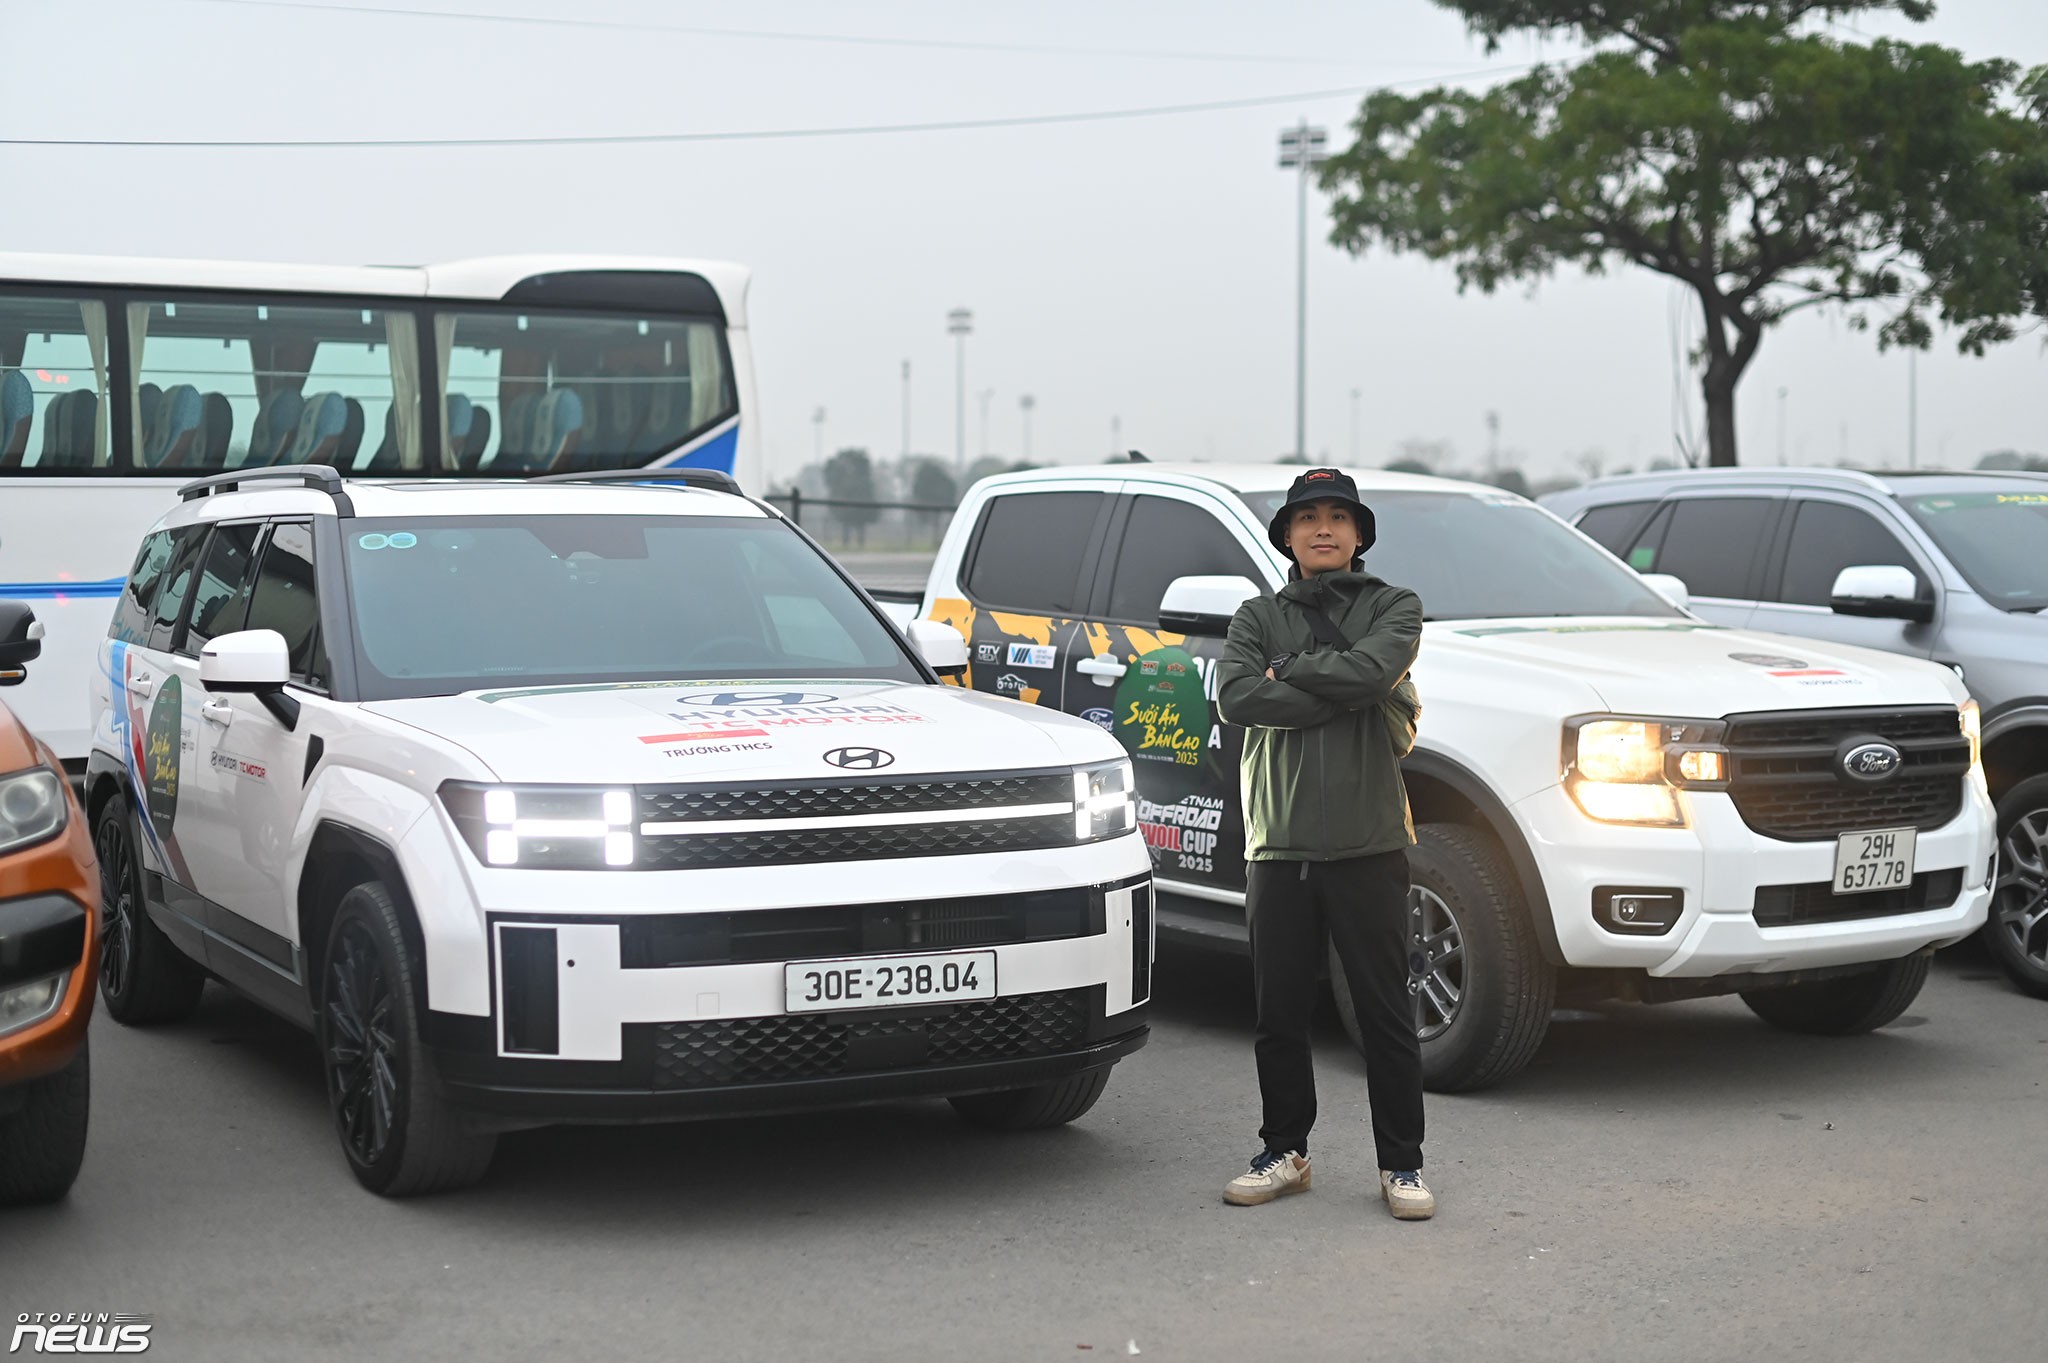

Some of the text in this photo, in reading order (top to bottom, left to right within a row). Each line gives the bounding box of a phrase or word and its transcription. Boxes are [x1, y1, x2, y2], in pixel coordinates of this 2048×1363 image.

[668, 705, 910, 721] HYUNDAI
[688, 714, 925, 730] TC MOTOR
[731, 742, 773, 752] THCS
[1175, 751, 1198, 766] 2025
[1859, 751, 1890, 773] Ford
[1180, 794, 1224, 810] ETNAM
[1183, 829, 1218, 856] CUP
[1860, 833, 1896, 860] 29H
[1178, 853, 1213, 873] 2025
[1843, 860, 1905, 889] 637.78
[804, 961, 979, 1002] 30E-238.04
